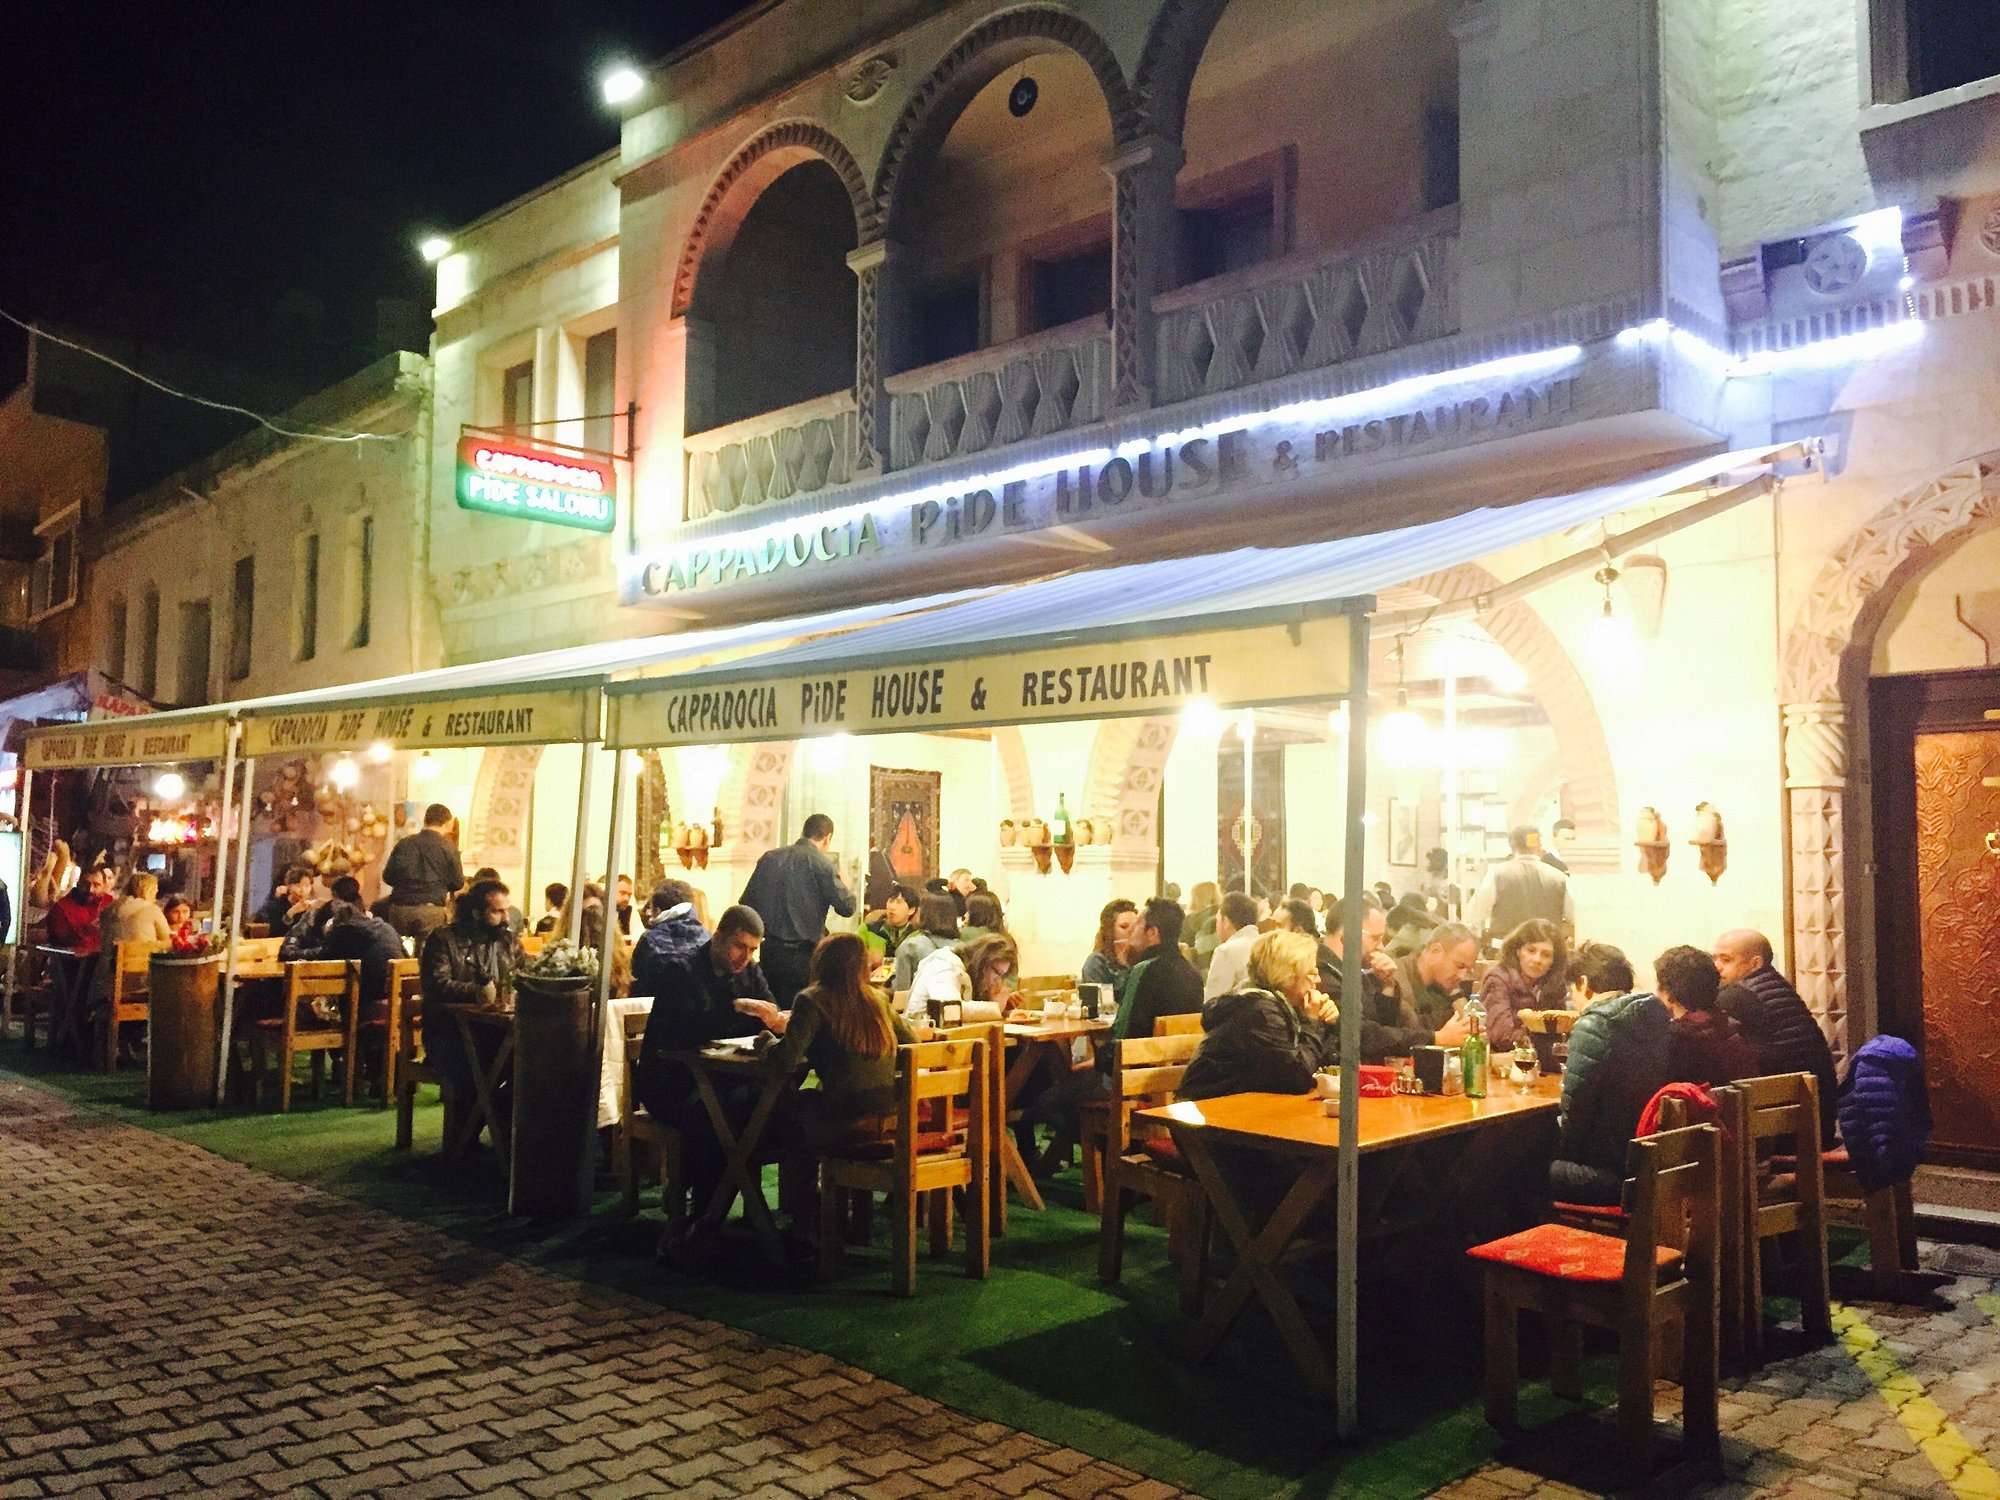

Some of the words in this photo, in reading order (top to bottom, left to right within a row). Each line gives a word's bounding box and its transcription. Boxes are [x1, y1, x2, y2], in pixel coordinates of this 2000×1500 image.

[911, 479, 1028, 545] PiDE
[1056, 428, 1249, 514] HOUSE
[1271, 440, 1299, 482] &
[1314, 376, 1581, 463] RESTAURANT
[525, 483, 610, 521] SALONU
[667, 686, 778, 733] CAPPADOCIA
[801, 679, 848, 724] PiDE
[871, 668, 945, 718] HOUSE
[971, 676, 988, 711] &
[1022, 654, 1212, 707] RESTAURANT
[269, 714, 328, 746] CAPPADOCIA
[375, 707, 414, 739] HOUSE
[445, 707, 534, 736] RESTAURANT
